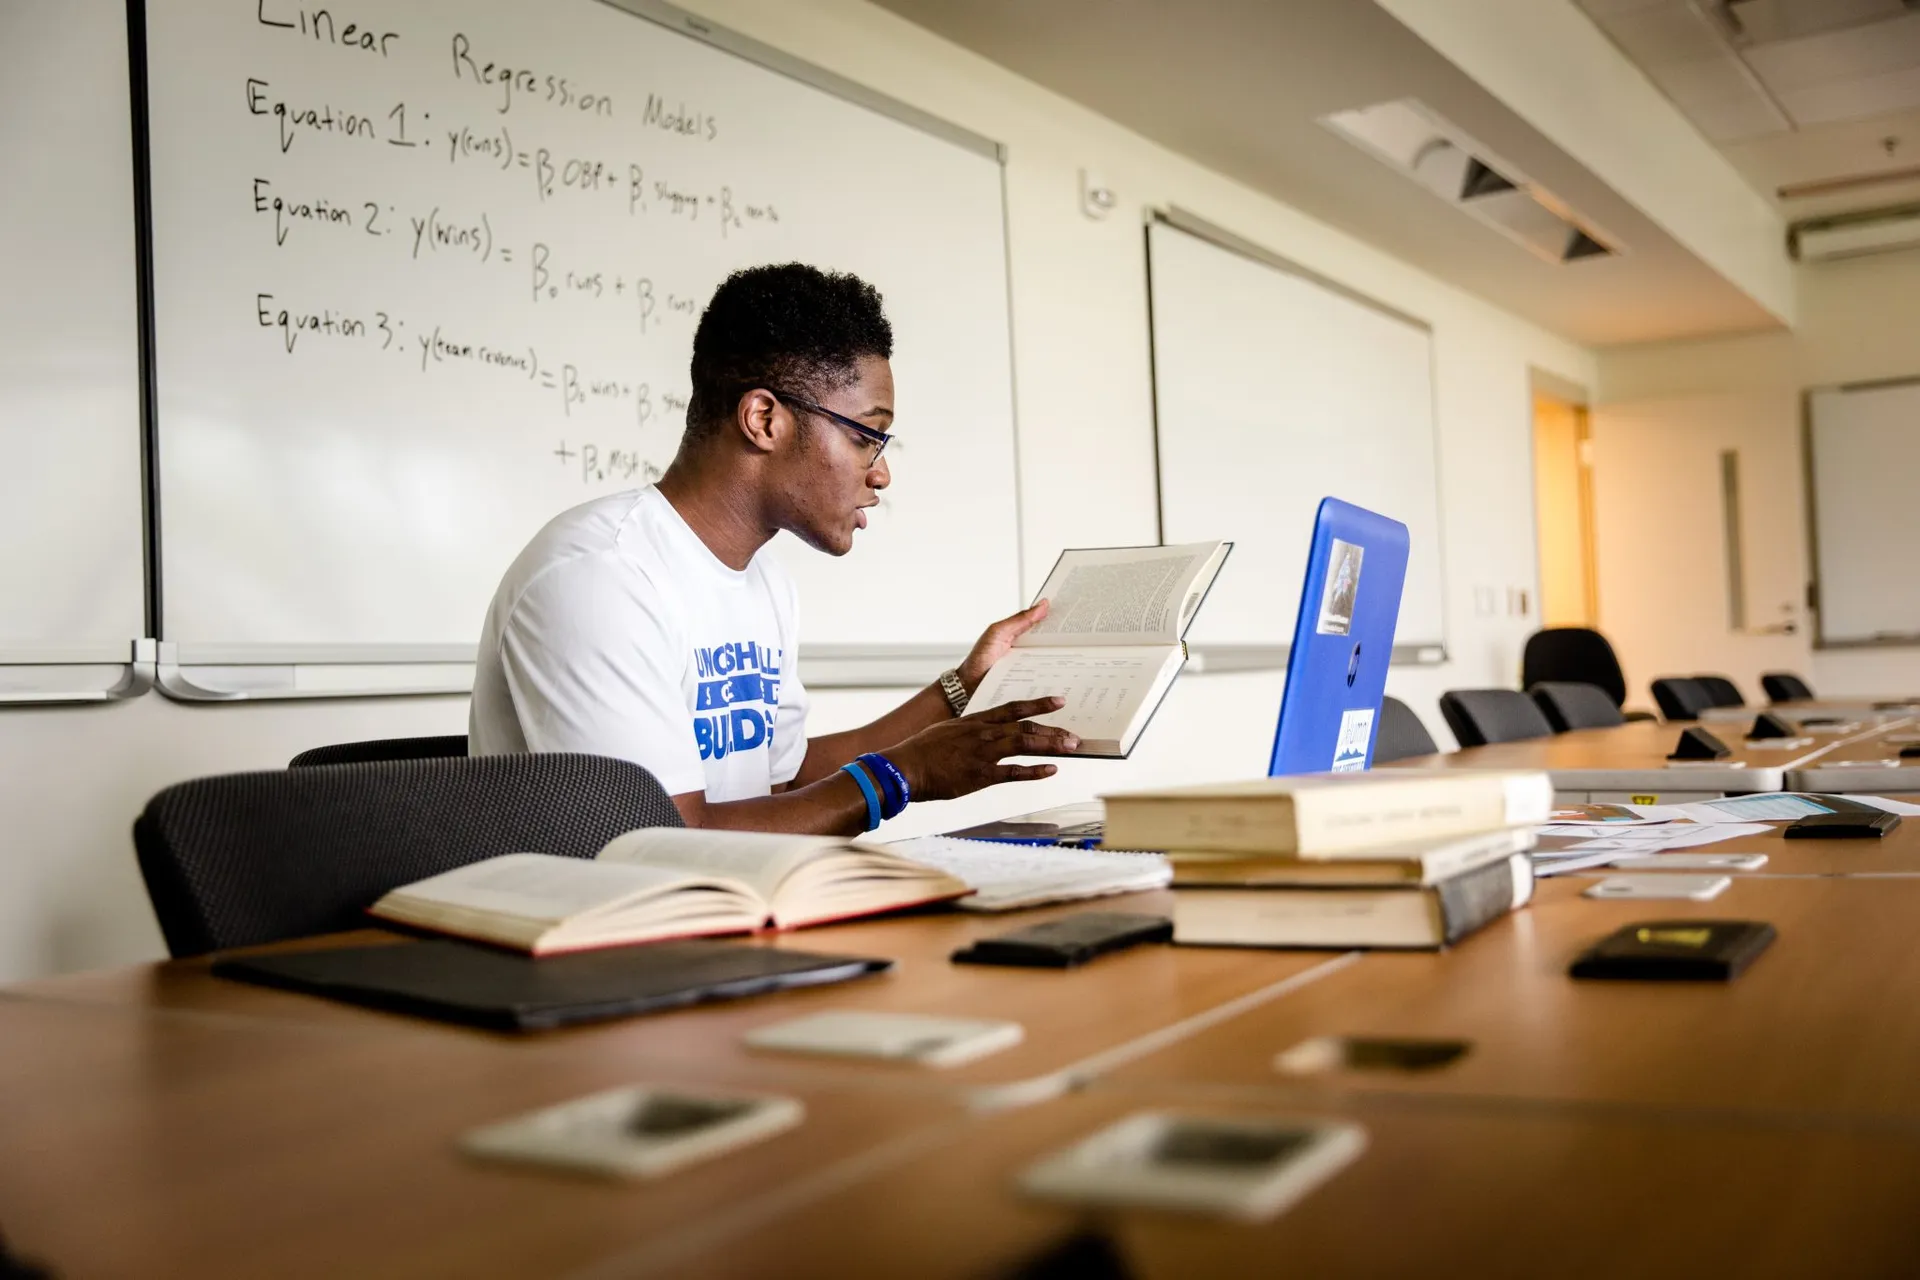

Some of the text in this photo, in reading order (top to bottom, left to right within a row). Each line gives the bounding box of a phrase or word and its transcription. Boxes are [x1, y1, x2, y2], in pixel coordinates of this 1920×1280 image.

[258, 0, 717, 142] Linear Regression Models
[247, 77, 375, 153] Equation
[254, 178, 351, 247] Equation
[257, 294, 365, 353] Equation
